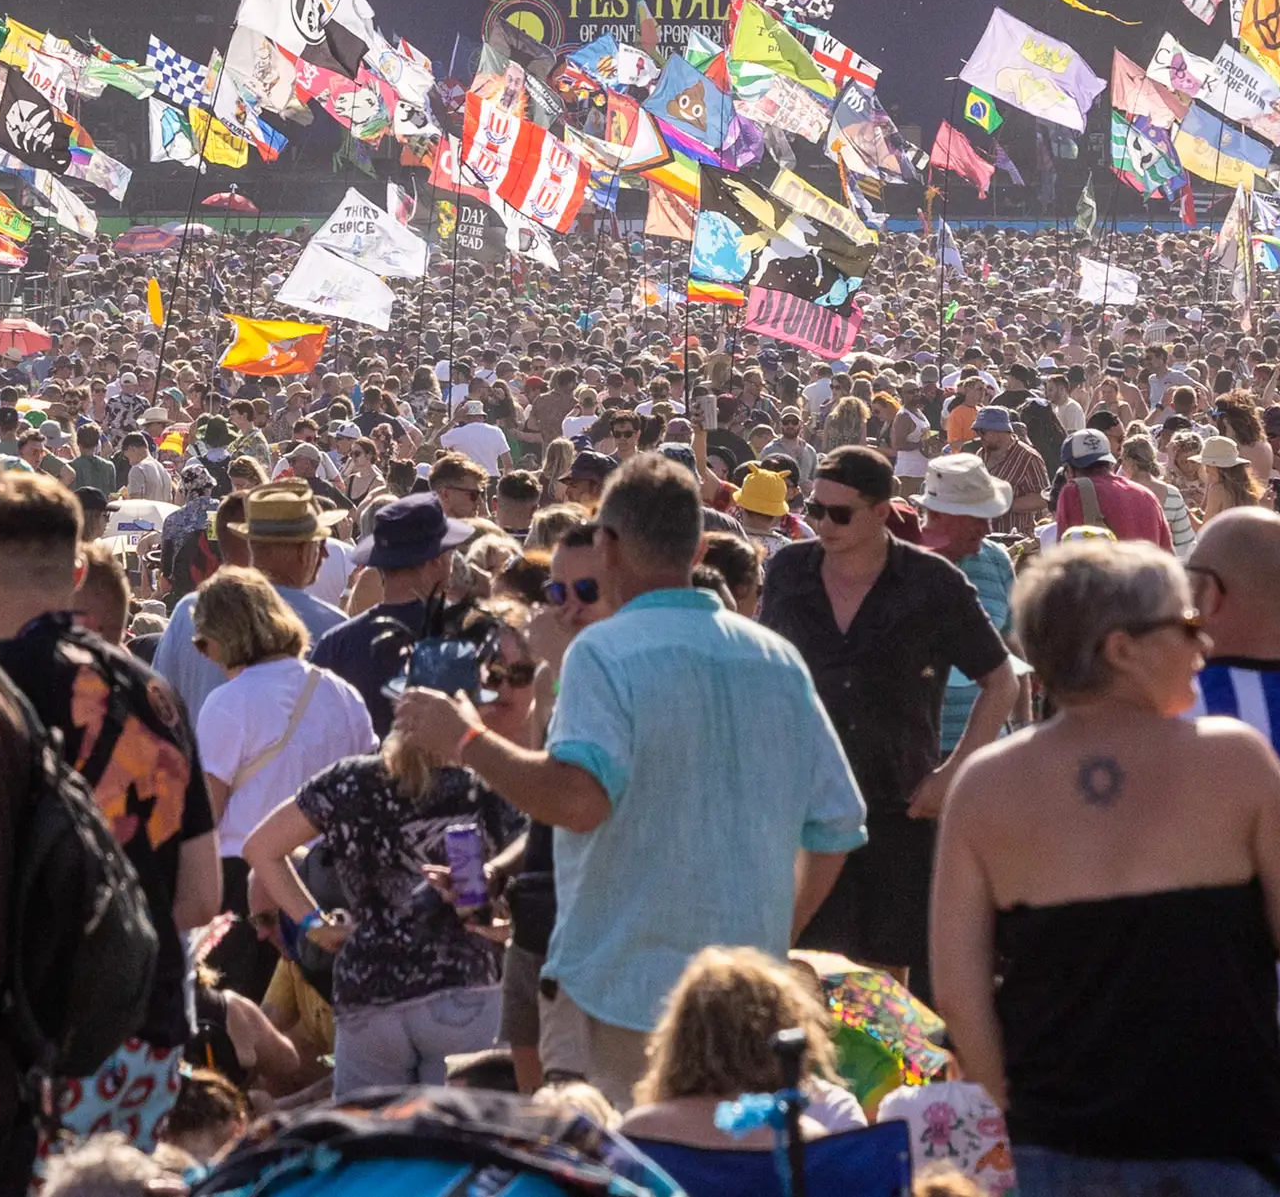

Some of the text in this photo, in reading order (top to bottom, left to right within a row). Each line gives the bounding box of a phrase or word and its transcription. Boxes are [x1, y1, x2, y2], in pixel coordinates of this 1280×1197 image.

[579, 24, 598, 43] OF
[1216, 56, 1260, 91] KENDALL
[1225, 72, 1243, 94] THE
[343, 205, 380, 221] THIRD
[461, 206, 488, 226] DAY
[329, 221, 377, 236] CHOICE
[459, 225, 484, 238] OF THE
[456, 234, 484, 251] DEAD
